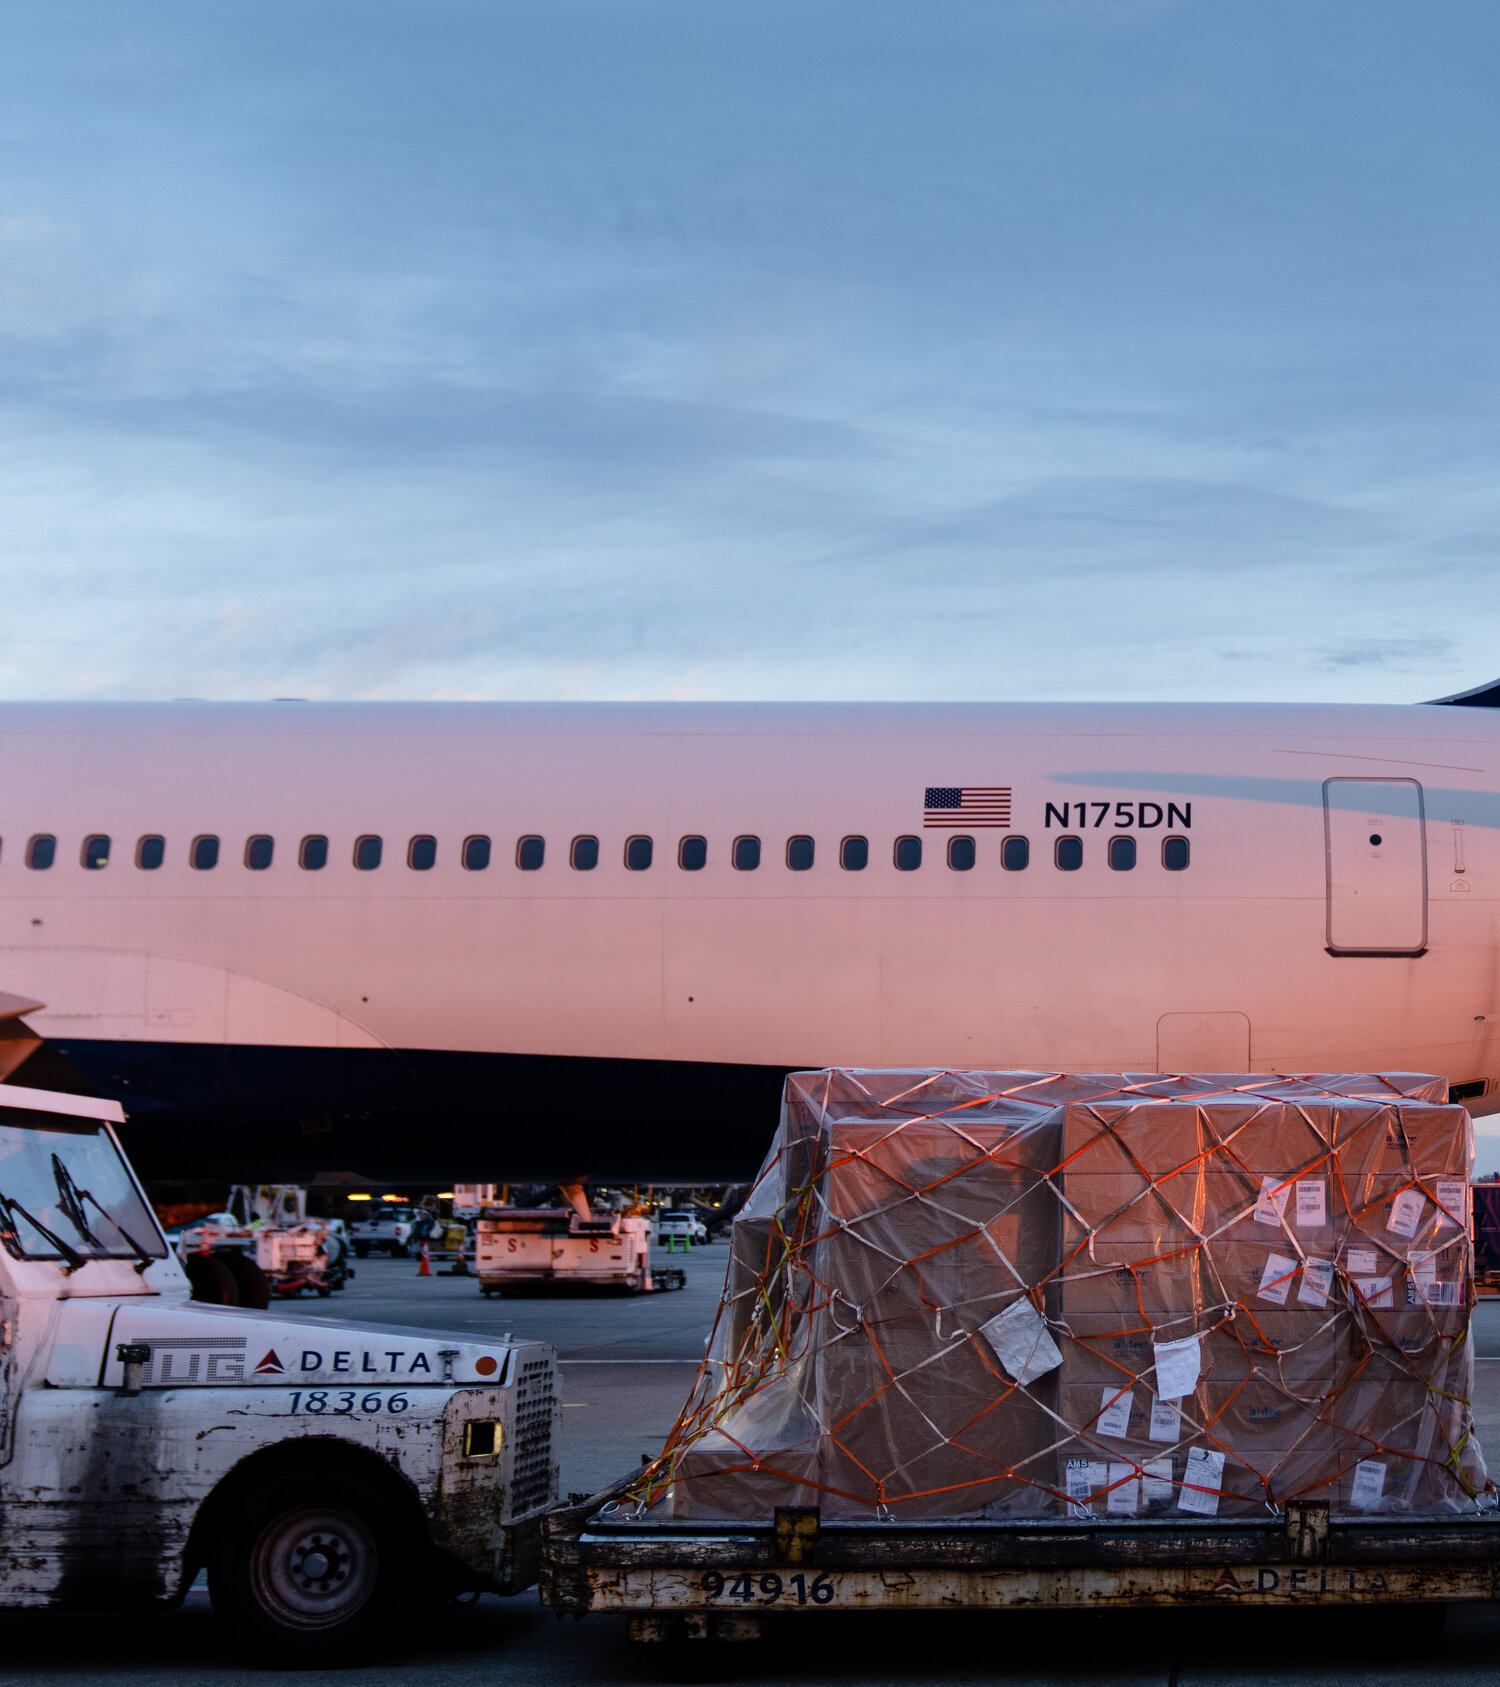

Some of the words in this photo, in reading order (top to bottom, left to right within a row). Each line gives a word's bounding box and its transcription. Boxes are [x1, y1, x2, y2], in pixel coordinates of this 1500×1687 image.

[1044, 802, 1192, 829] N175DN
[1407, 1281, 1416, 1304] AMS
[131, 1337, 247, 1383] TUG
[300, 1350, 431, 1373] DELTA
[288, 1390, 409, 1416] 18366
[1067, 1460, 1088, 1469] AMS
[701, 1569, 836, 1606] 94916
[1258, 1567, 1391, 1594] DELTA
